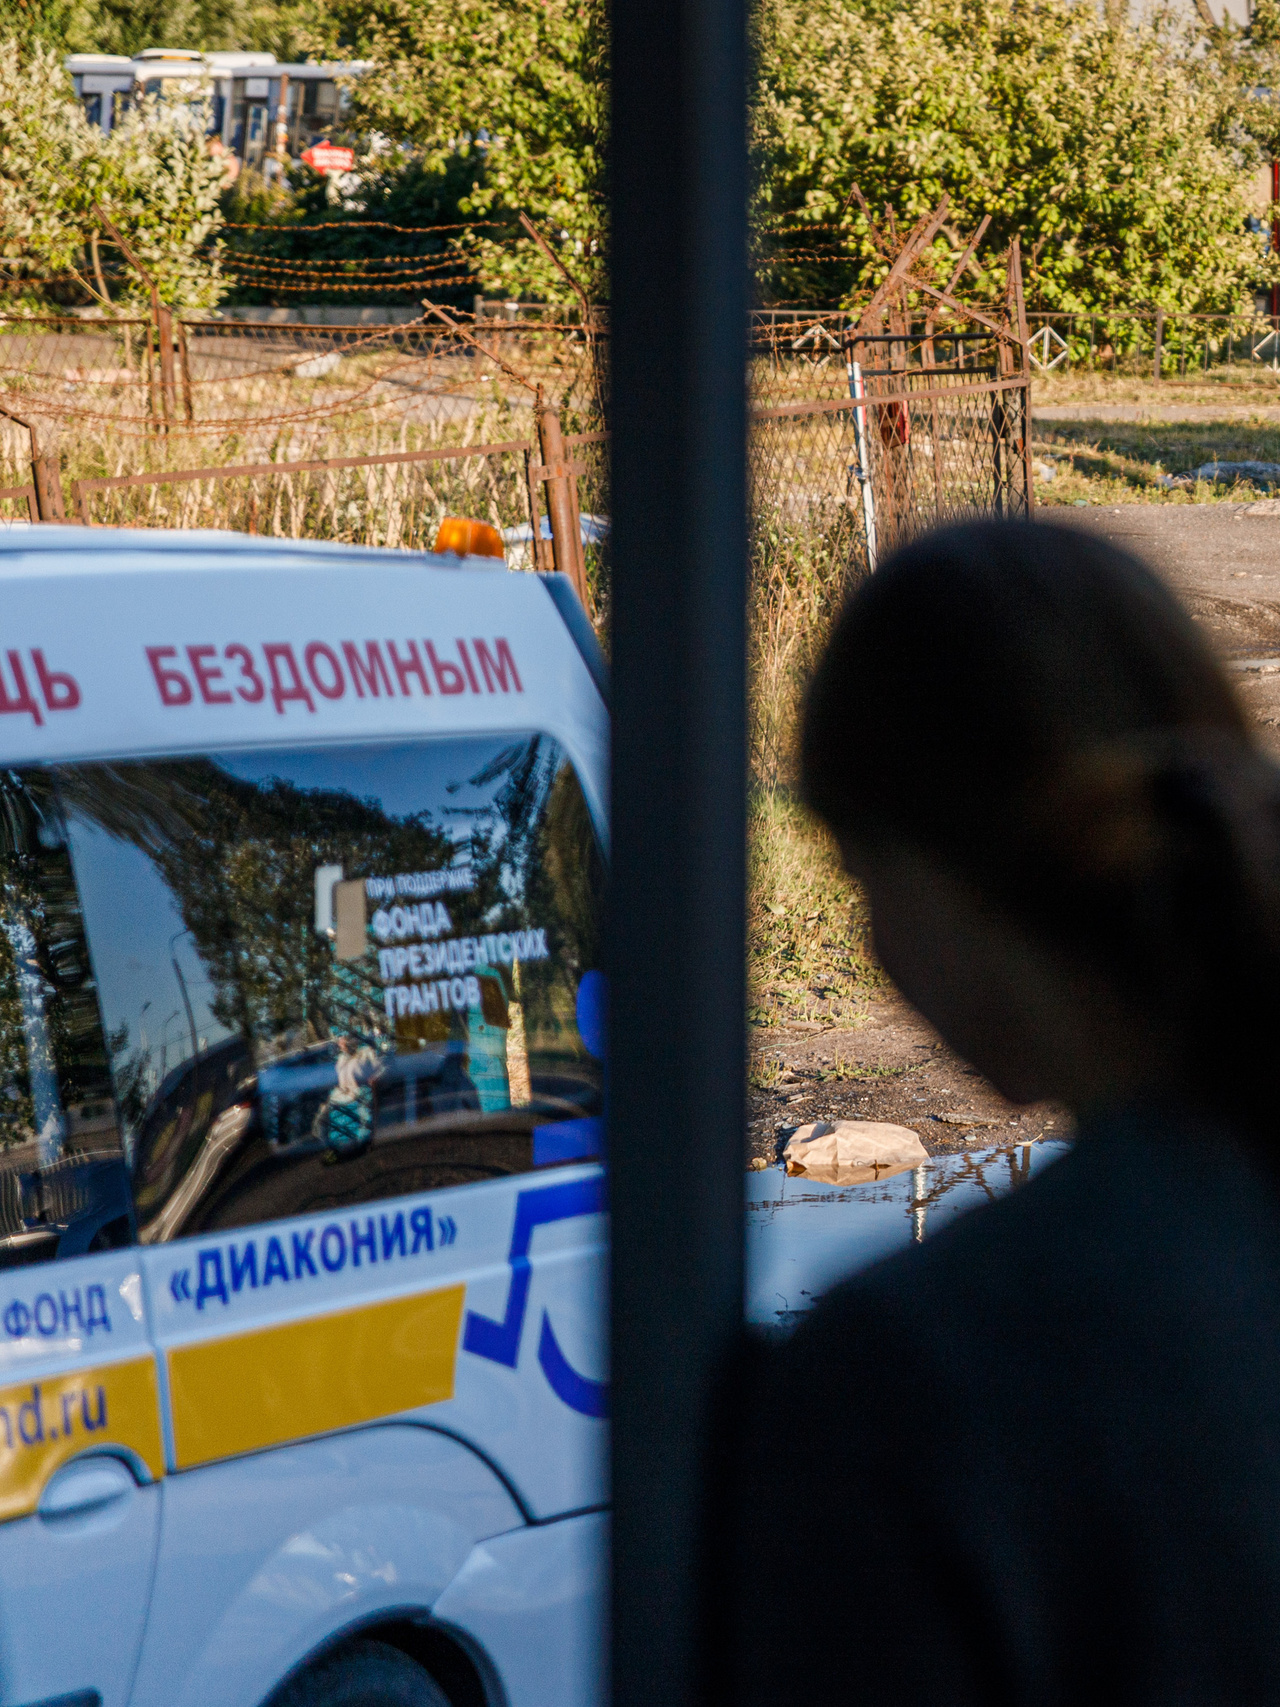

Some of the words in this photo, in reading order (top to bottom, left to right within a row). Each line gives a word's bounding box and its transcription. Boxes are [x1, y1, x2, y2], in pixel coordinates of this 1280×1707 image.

[145, 637, 524, 715] БЕЗДОМНЫМ
[366, 876, 397, 899] ПРИ
[371, 900, 453, 940] ФОНДА
[378, 928, 549, 979] ПРЕЗИДЕНТСКИХ
[383, 974, 482, 1016] ГРАНТОВ
[3, 1283, 112, 1338] ФОНД
[169, 1205, 458, 1308] «ДИАКОНИЯ»
